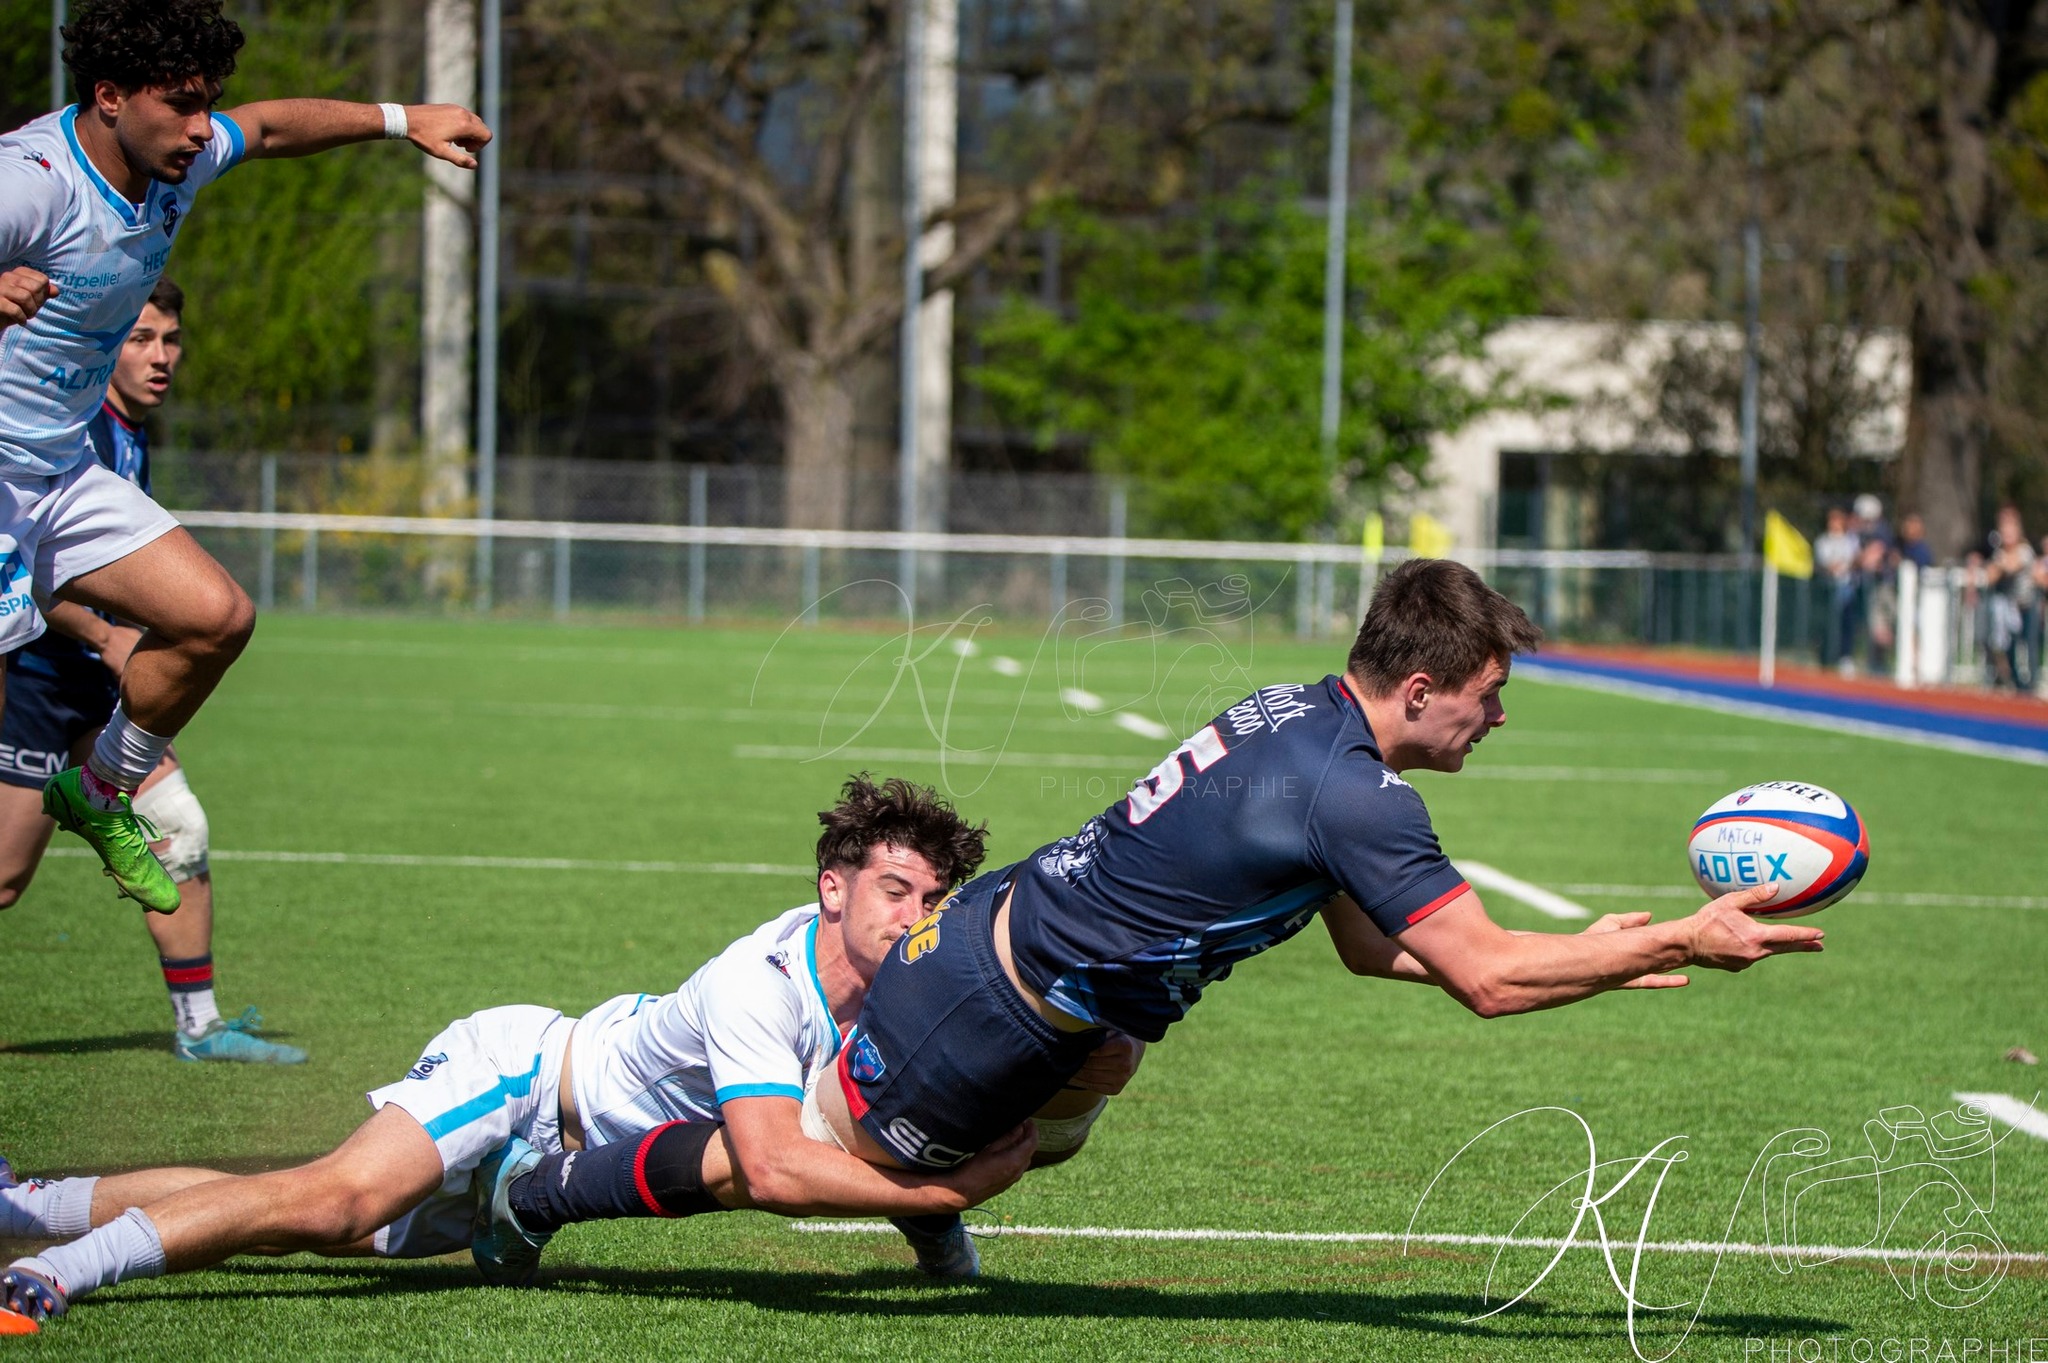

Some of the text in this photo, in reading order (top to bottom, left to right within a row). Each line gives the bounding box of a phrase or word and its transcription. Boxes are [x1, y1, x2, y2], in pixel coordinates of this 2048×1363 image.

[49, 271, 121, 289] ntpellier
[1227, 699, 1265, 735] 2000
[1717, 826, 1763, 845] MATCH
[1698, 852, 1793, 883] ADEX
[889, 1117, 976, 1165] EC
